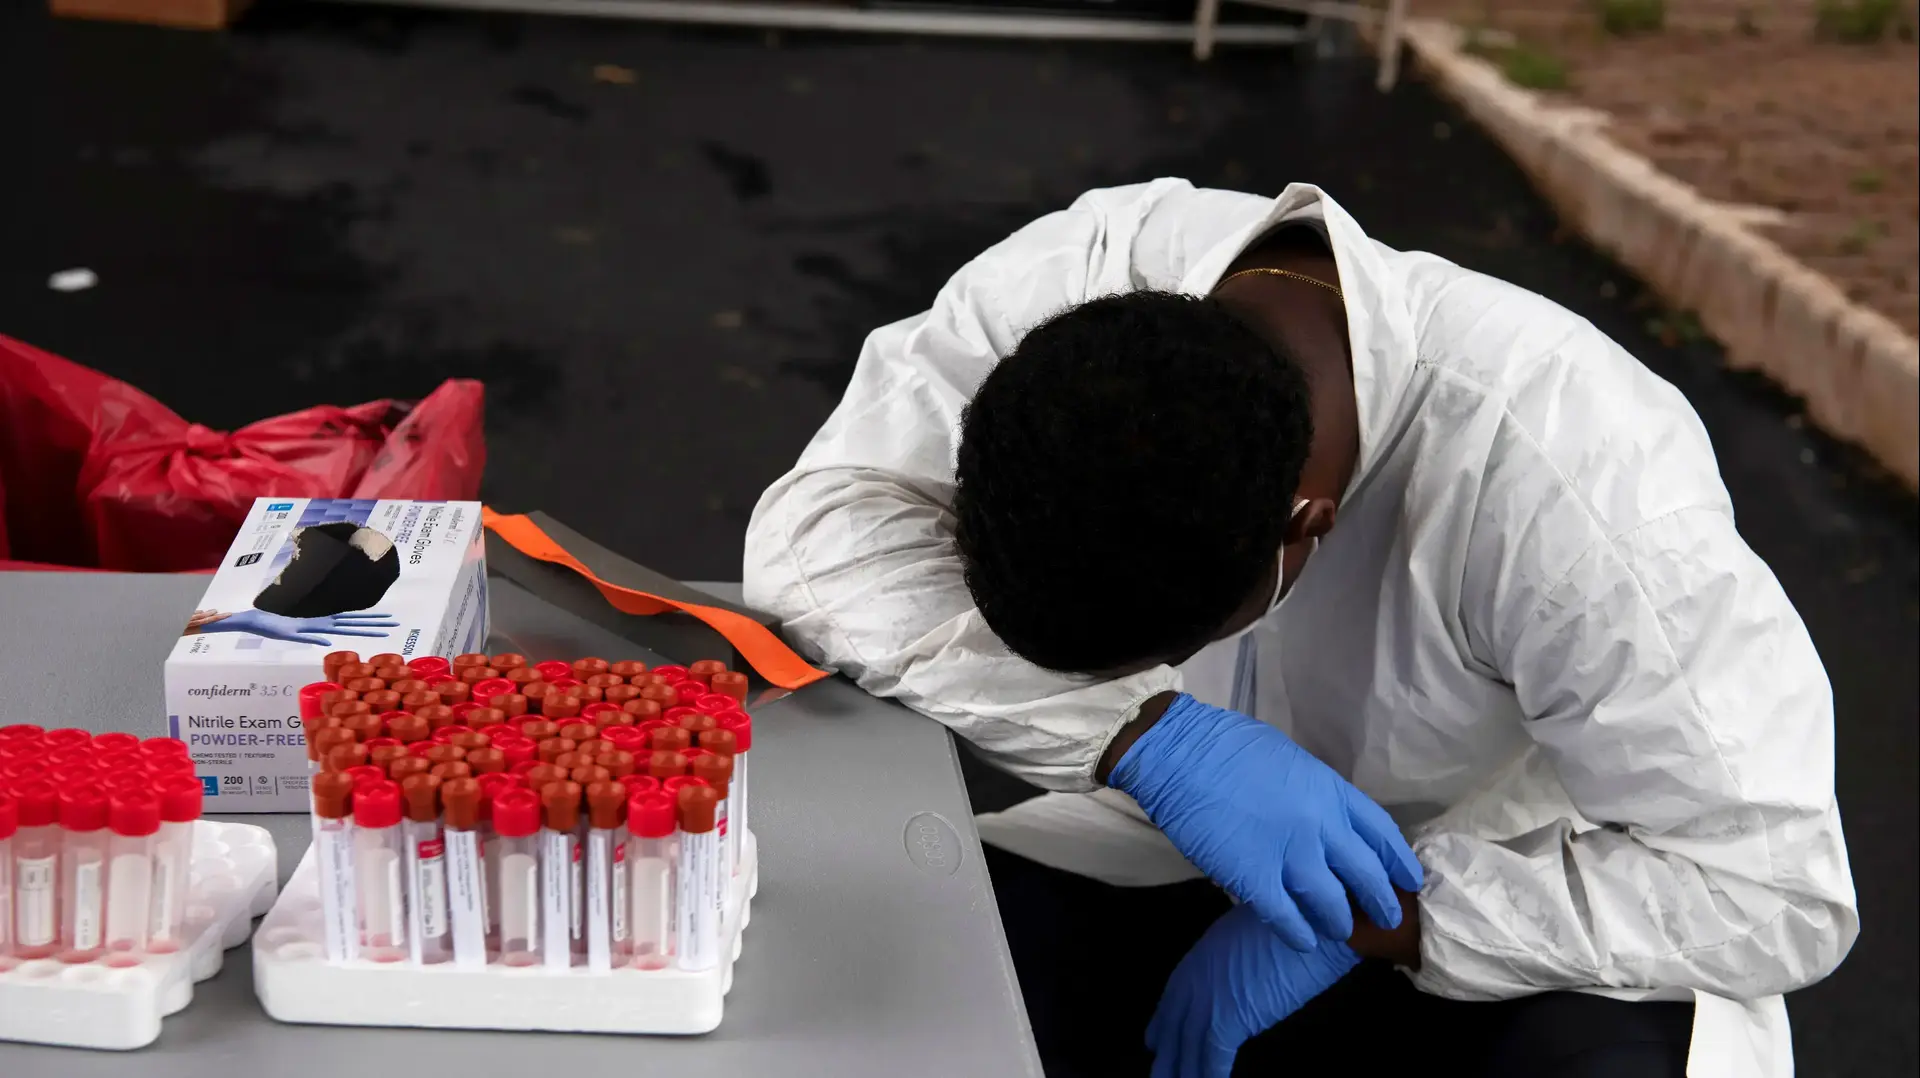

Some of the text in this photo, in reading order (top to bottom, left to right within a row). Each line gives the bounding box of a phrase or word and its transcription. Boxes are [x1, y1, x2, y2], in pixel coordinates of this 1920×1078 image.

[409, 505, 445, 566] Nitrile Exam Gloves
[259, 684, 278, 697] 3.5
[282, 684, 293, 697] C
[188, 715, 235, 729] Nitrile
[239, 715, 282, 729] Exam
[190, 734, 307, 746] POWDER-FREE
[223, 776, 243, 785] 200
